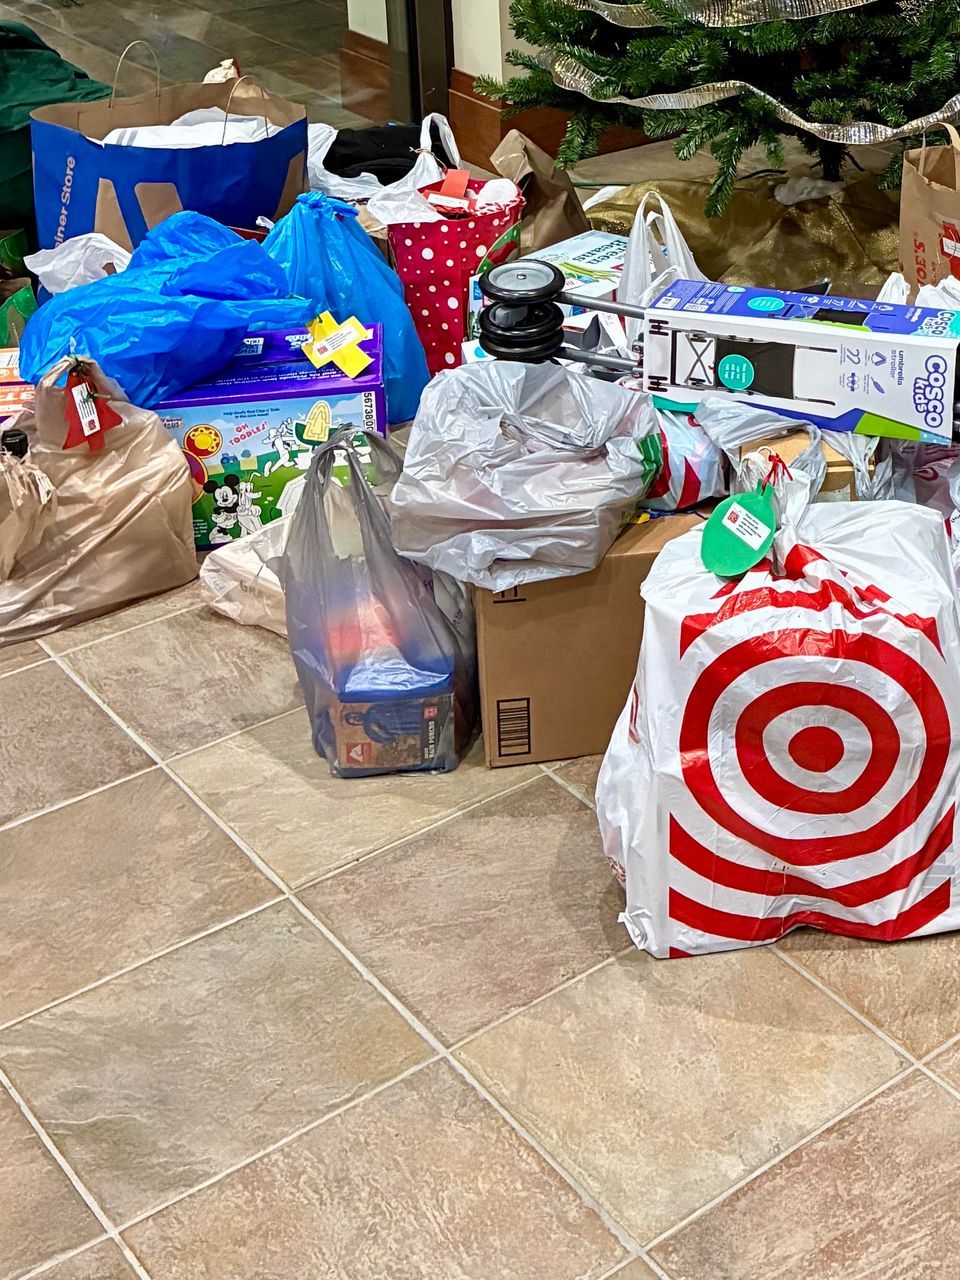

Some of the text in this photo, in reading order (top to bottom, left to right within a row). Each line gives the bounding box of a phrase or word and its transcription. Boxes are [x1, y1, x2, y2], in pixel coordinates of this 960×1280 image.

[61, 156, 76, 206] Store
[572, 239, 628, 261] Beans
[585, 245, 627, 265] reen
[931, 311, 956, 336] COSCO
[897, 350, 905, 386] umbrella
[912, 376, 930, 414] kids
[924, 355, 948, 428] COSCO
[229, 421, 268, 446] TOODLES!
[235, 422, 249, 433] OH
